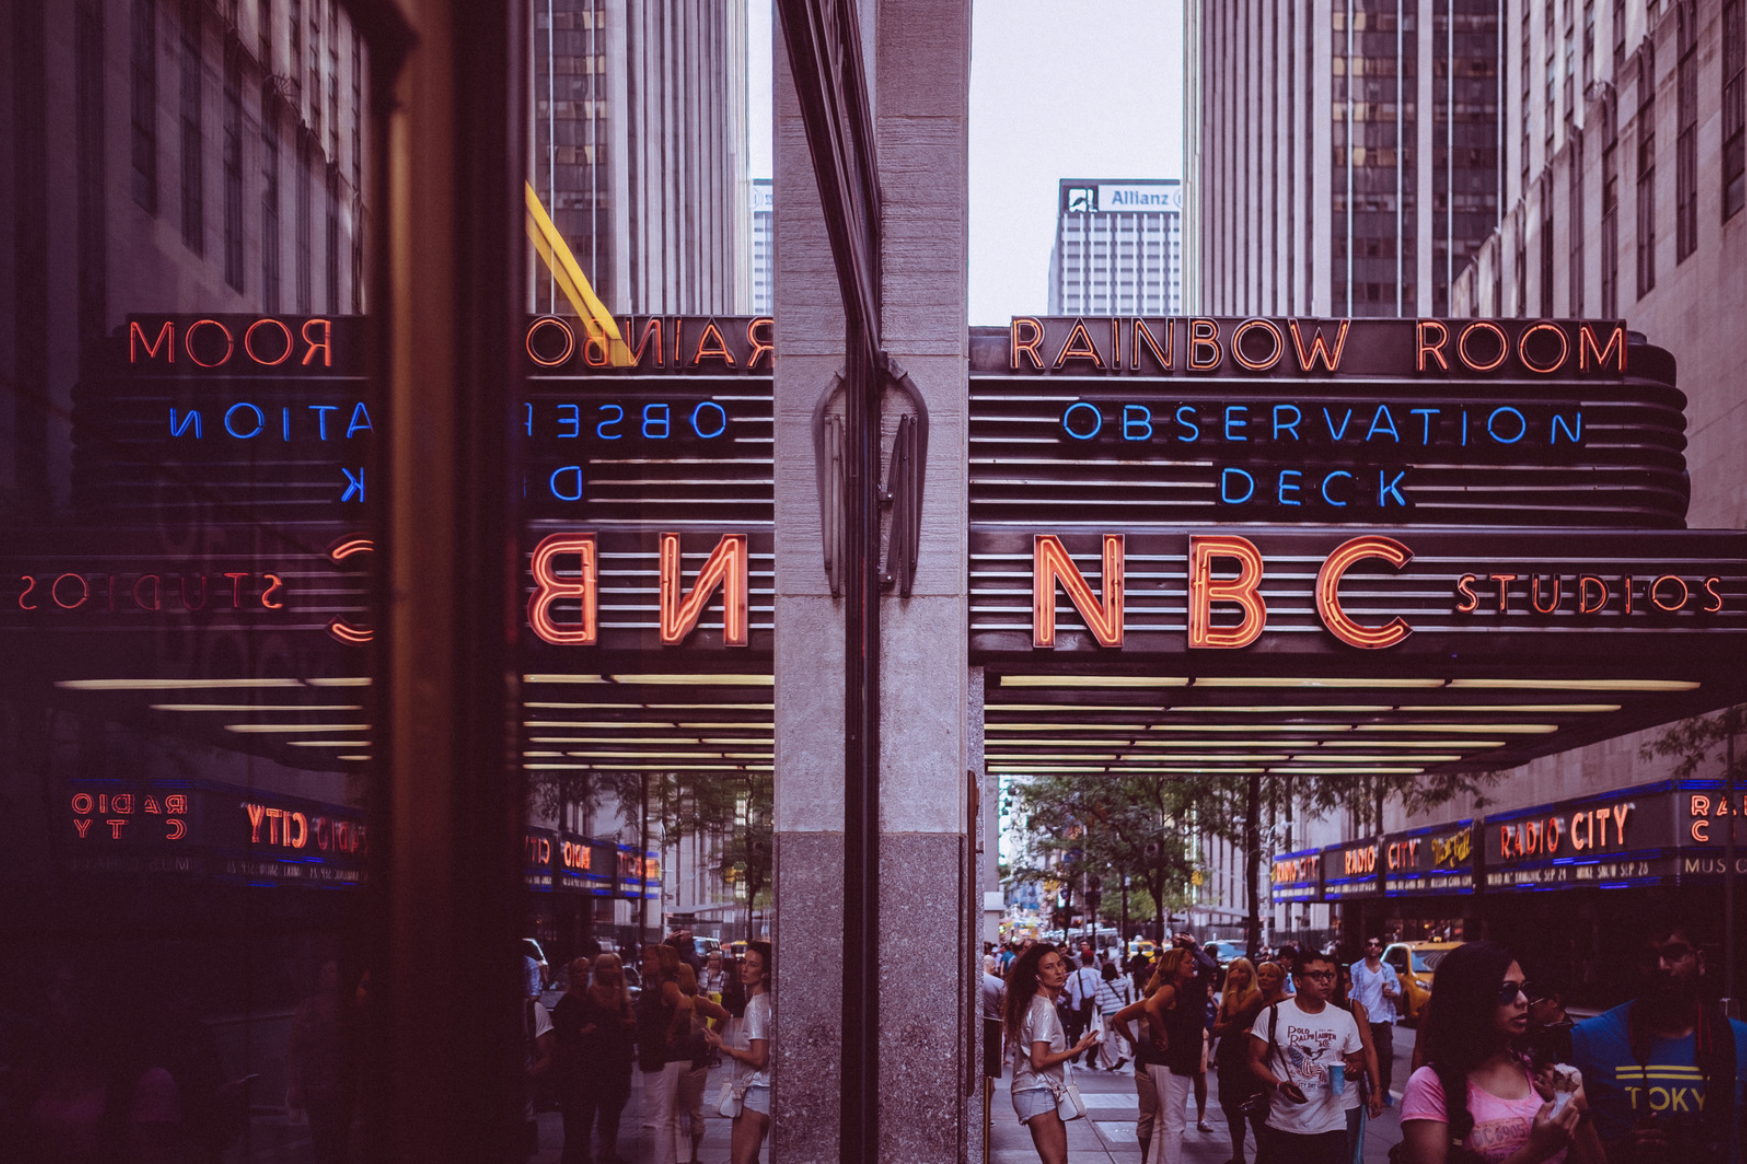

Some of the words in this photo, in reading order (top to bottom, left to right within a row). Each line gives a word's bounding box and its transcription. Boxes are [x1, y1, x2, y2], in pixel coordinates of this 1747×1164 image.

[1112, 191, 1169, 205] Allianz
[1010, 316, 1351, 372] RAINBOW
[1415, 318, 1628, 374] ROOM
[1062, 402, 1582, 446] OBSERVATION
[1222, 468, 1407, 508] DECK
[1033, 534, 1416, 650] NBC
[1456, 572, 1724, 615] STUDIOS
[1500, 817, 1559, 859] RADIO
[1571, 803, 1629, 850] CITY
[1345, 845, 1375, 875] RADIO
[1388, 839, 1417, 870] CITY
[1684, 858, 1747, 873] MUSC
[1287, 1025, 1310, 1038] POLO
